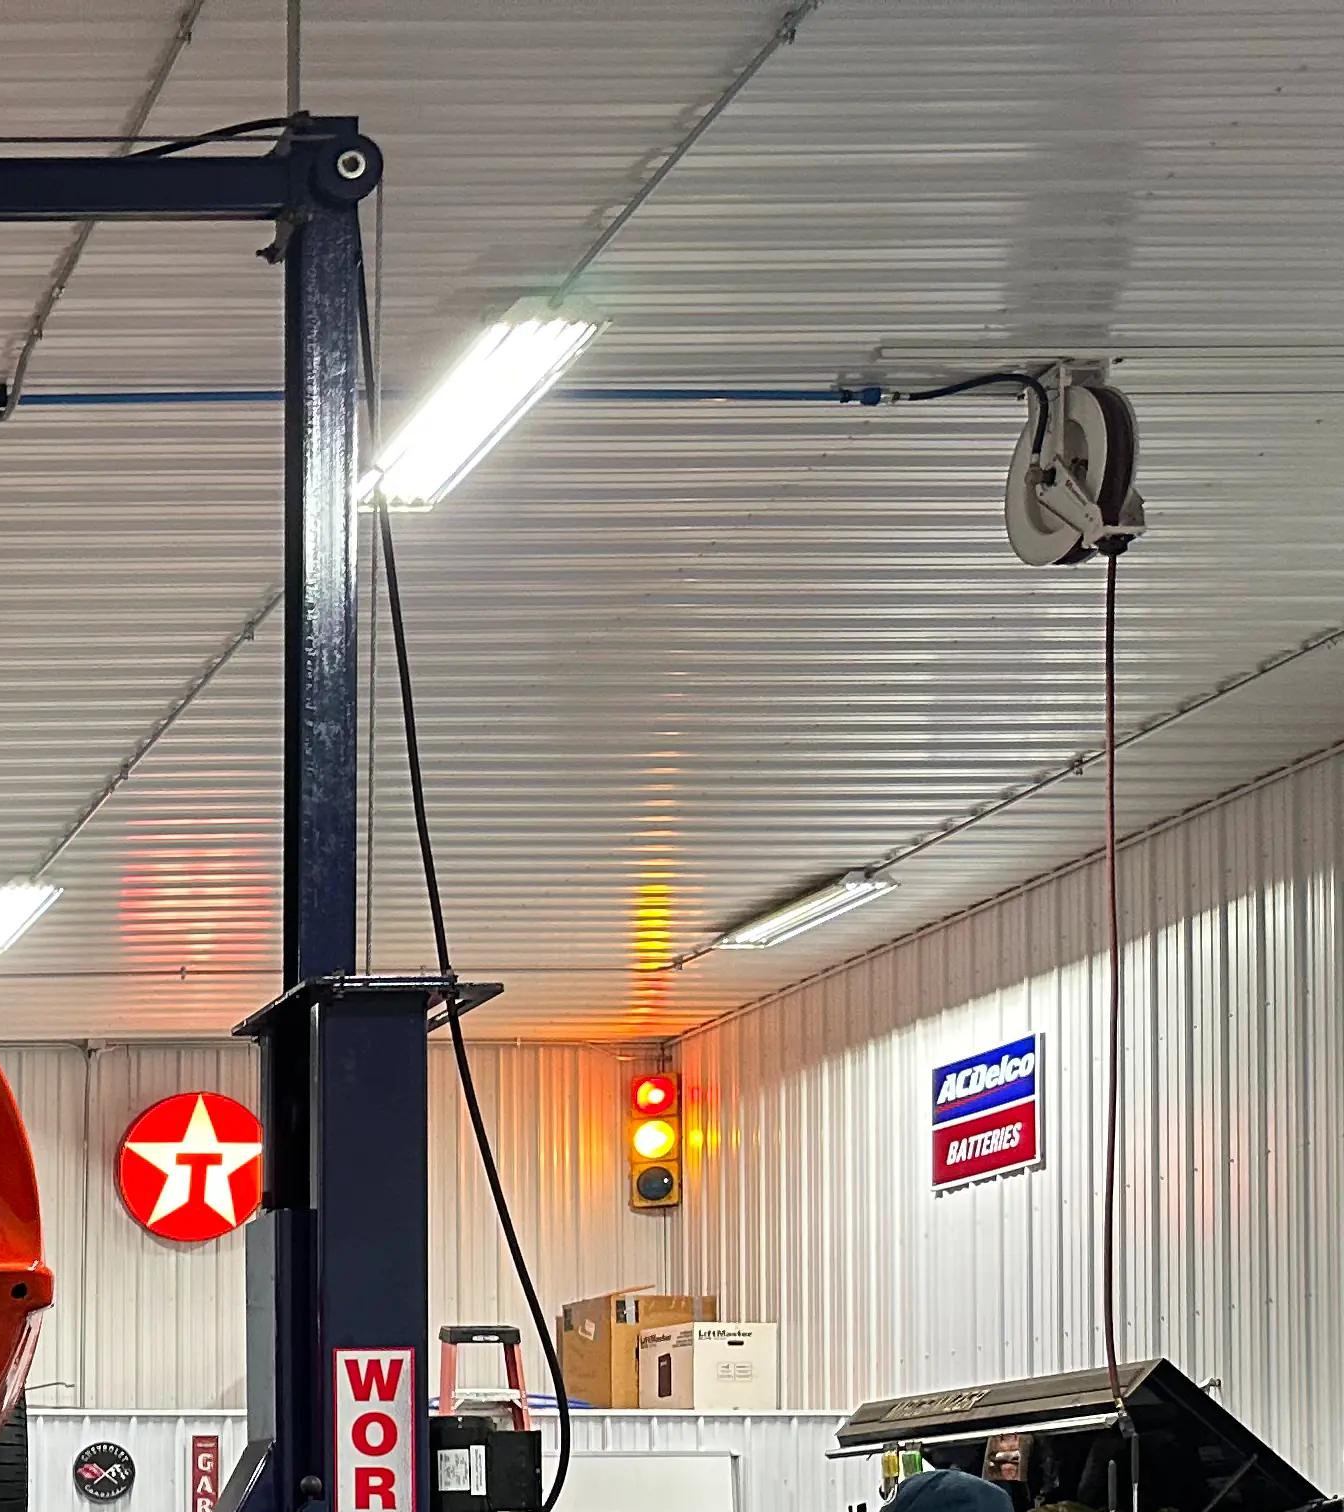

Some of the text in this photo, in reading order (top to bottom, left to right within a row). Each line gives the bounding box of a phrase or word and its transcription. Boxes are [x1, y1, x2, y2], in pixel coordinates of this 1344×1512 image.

[937, 1052, 1035, 1105] ACDelco
[946, 1121, 1023, 1166] BATTERIES
[81, 1444, 129, 1463] CHEVROLET
